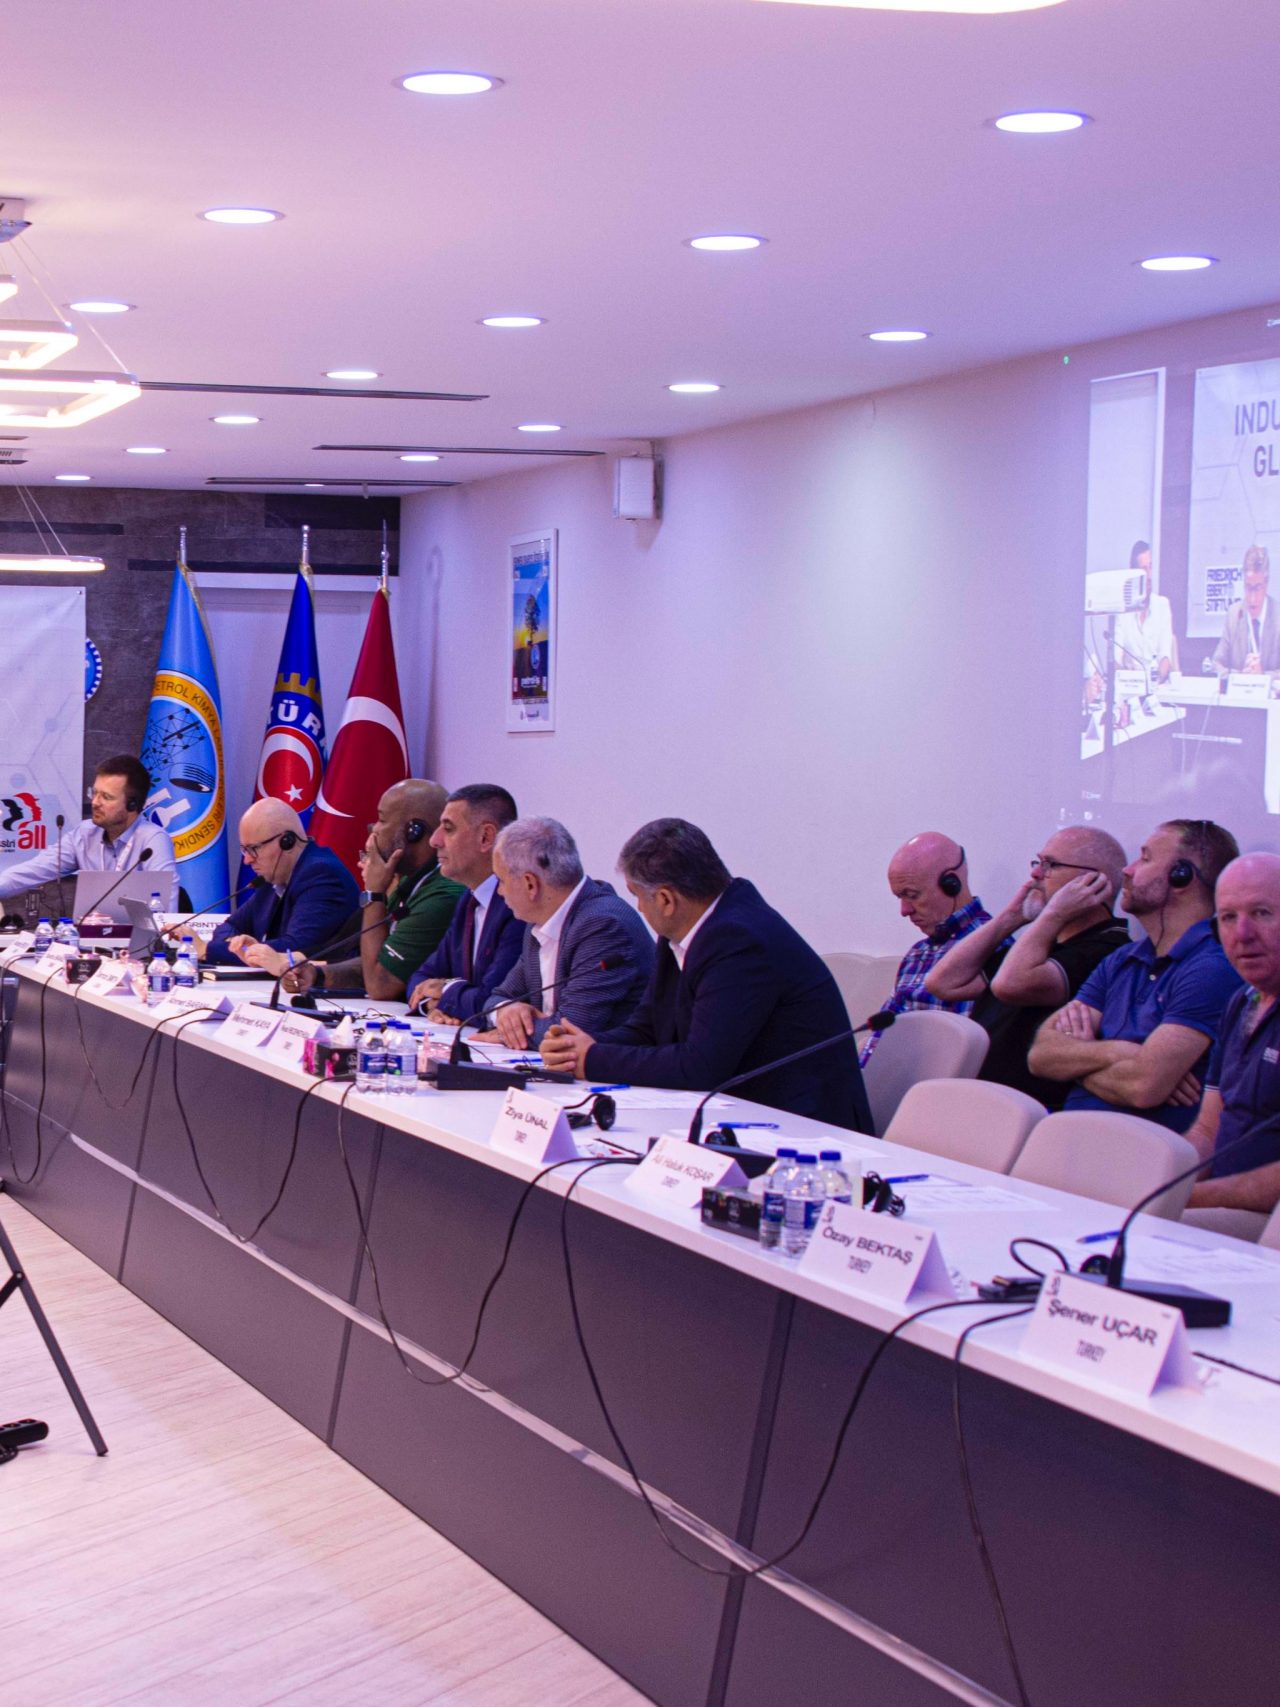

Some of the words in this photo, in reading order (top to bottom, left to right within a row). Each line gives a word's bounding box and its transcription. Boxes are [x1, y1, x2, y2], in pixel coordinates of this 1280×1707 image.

[1235, 400, 1280, 436] INDU
[1254, 446, 1280, 477] GL
[153, 679, 189, 698] ETROL
[17, 824, 47, 850] all
[856, 1236, 914, 1265] BEKTAŞ
[1048, 1298, 1099, 1326] Şener
[1102, 1315, 1158, 1347] UÇAR
